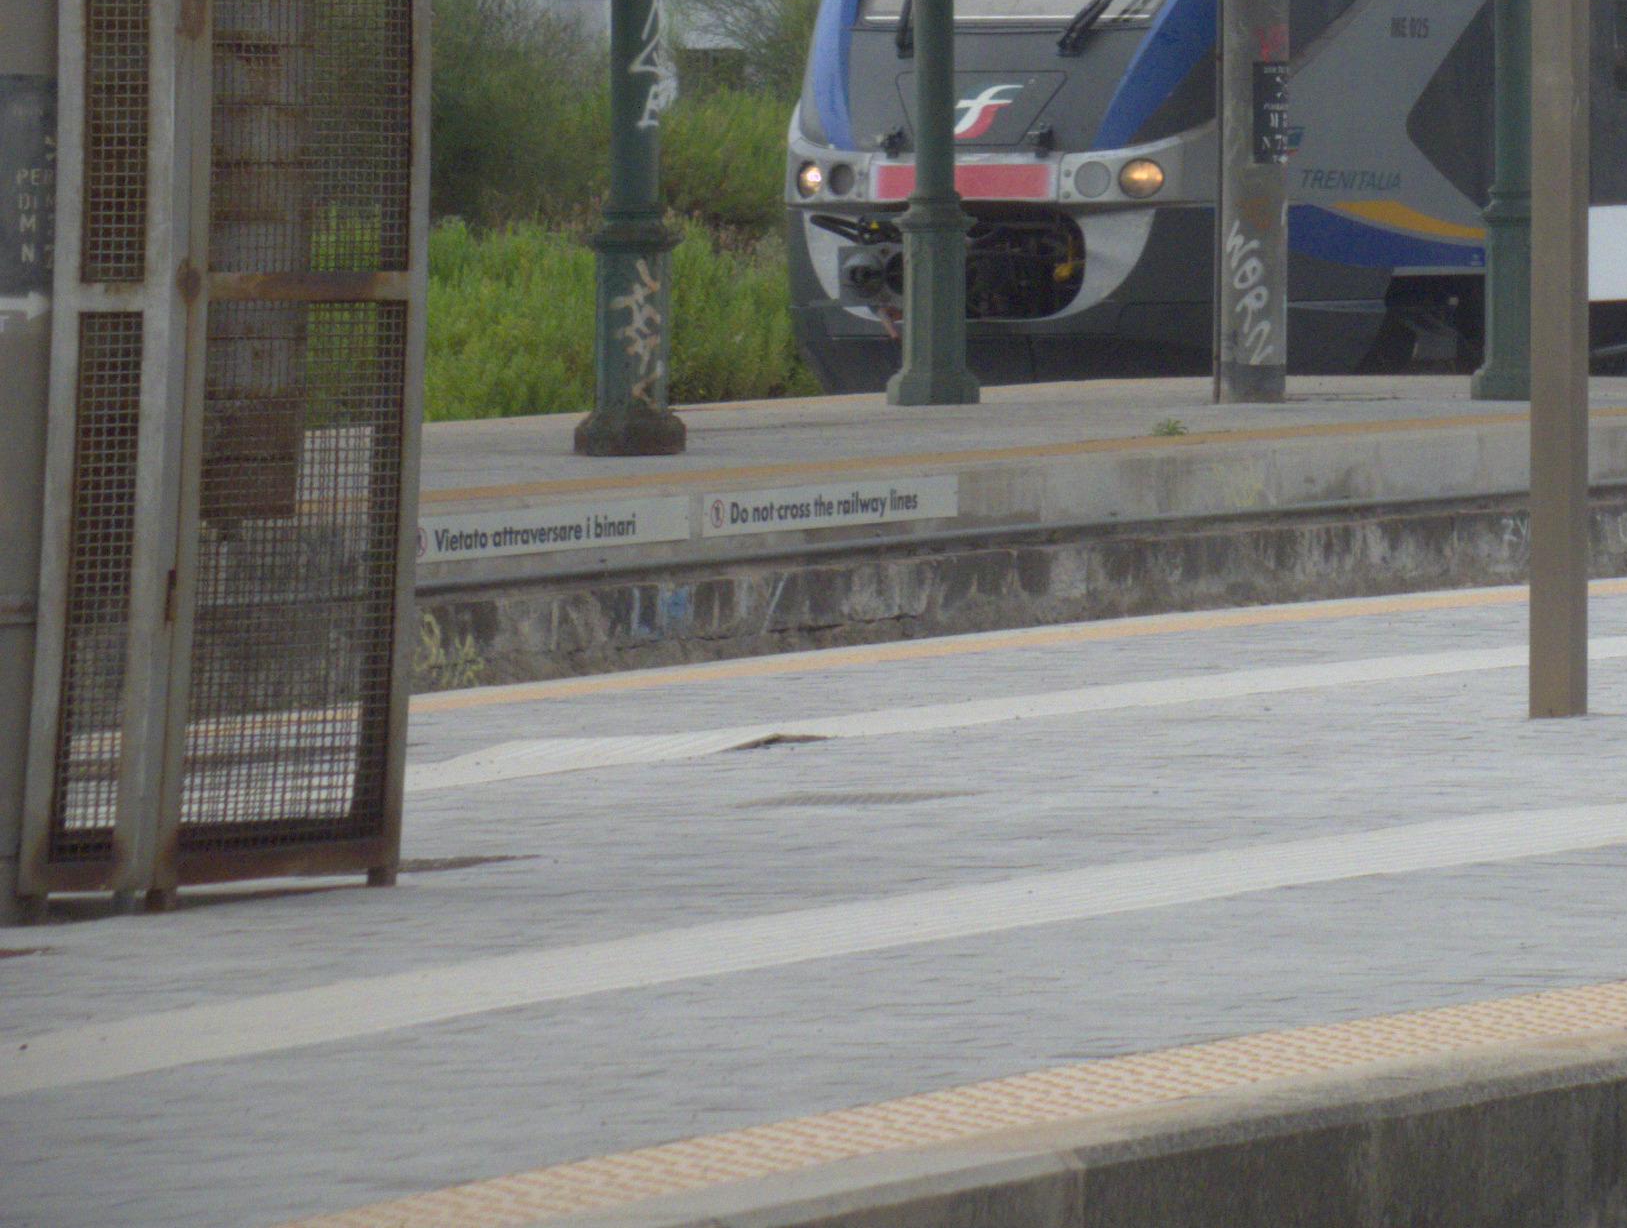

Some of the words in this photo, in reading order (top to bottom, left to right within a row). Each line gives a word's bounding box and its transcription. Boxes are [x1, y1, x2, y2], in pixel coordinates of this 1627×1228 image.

[1301, 169, 1402, 190] TRENITALIA
[730, 502, 749, 524] Do
[752, 502, 774, 523] not
[777, 502, 811, 520] cross
[813, 493, 833, 518] the
[837, 490, 887, 518] railway
[889, 488, 918, 512] lines
[434, 528, 488, 552] Vietato
[492, 524, 582, 548] attraversare
[586, 516, 591, 540] i
[594, 512, 637, 538] binari
